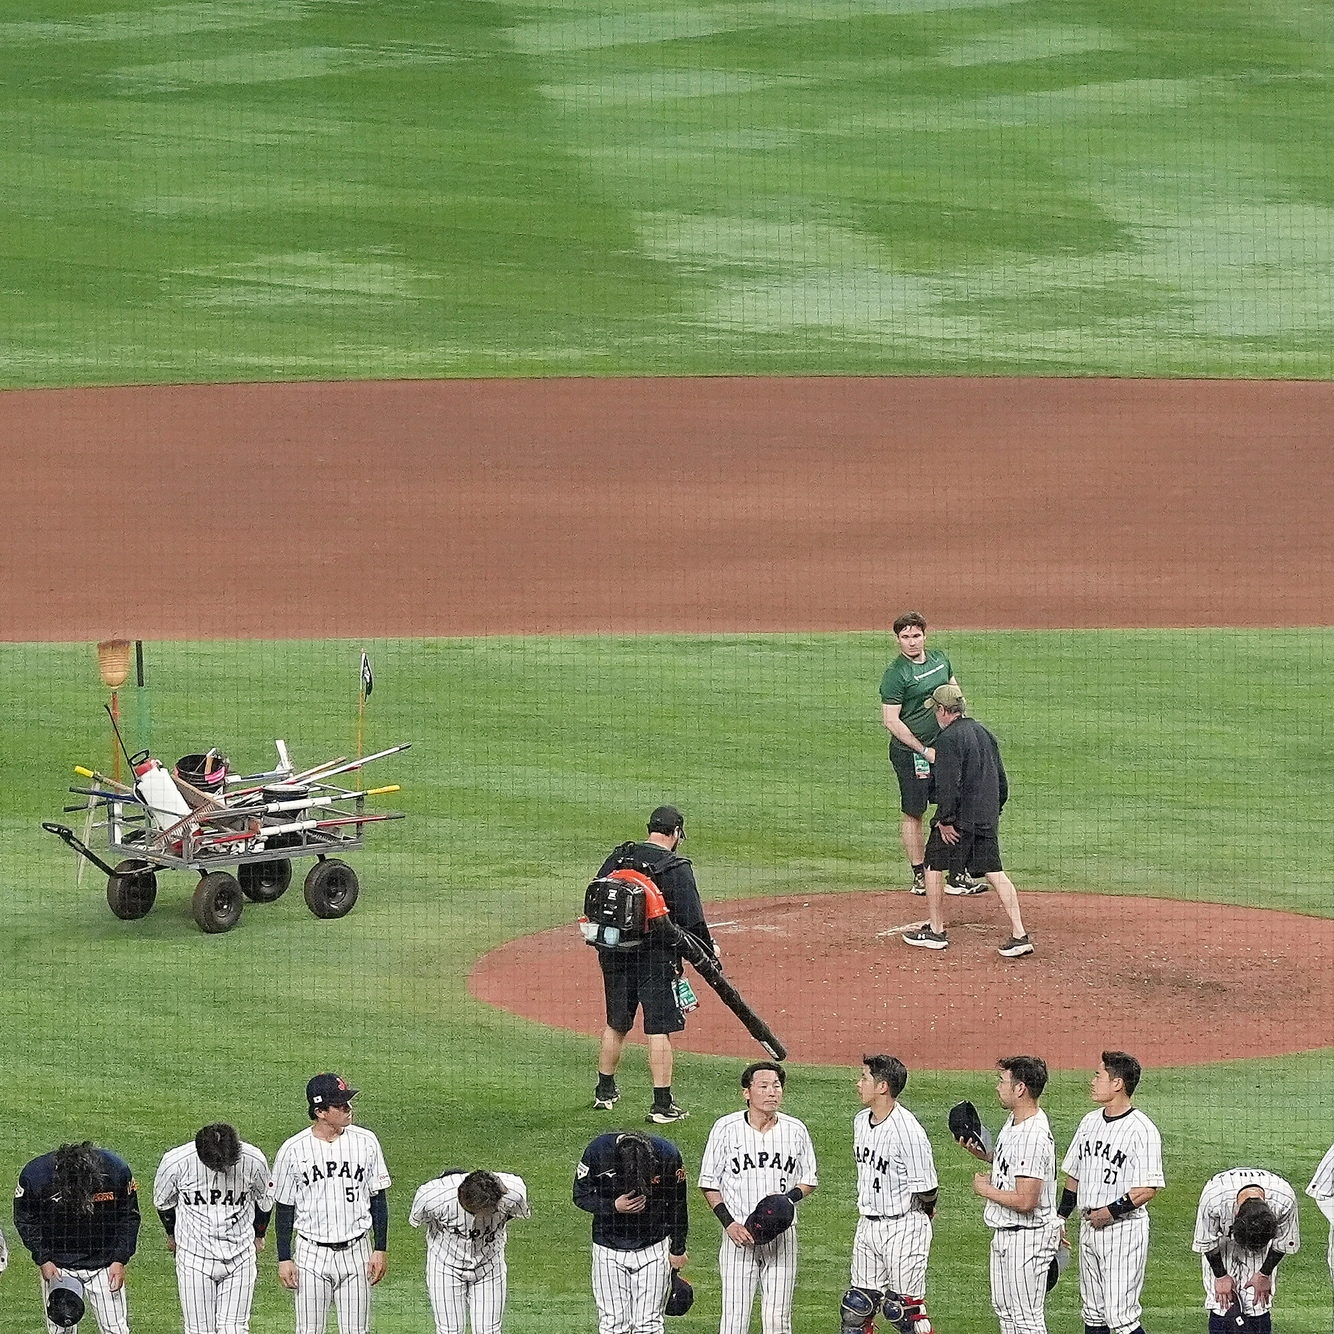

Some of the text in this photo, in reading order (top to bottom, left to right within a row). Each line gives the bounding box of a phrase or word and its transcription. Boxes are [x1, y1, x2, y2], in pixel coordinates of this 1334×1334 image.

[731, 1152, 796, 1175] JAPAN
[1078, 1141, 1127, 1169] JAPAN
[302, 1161, 365, 1187] JAPAN
[779, 1178, 787, 1193] 6
[872, 1177, 881, 1193] 4
